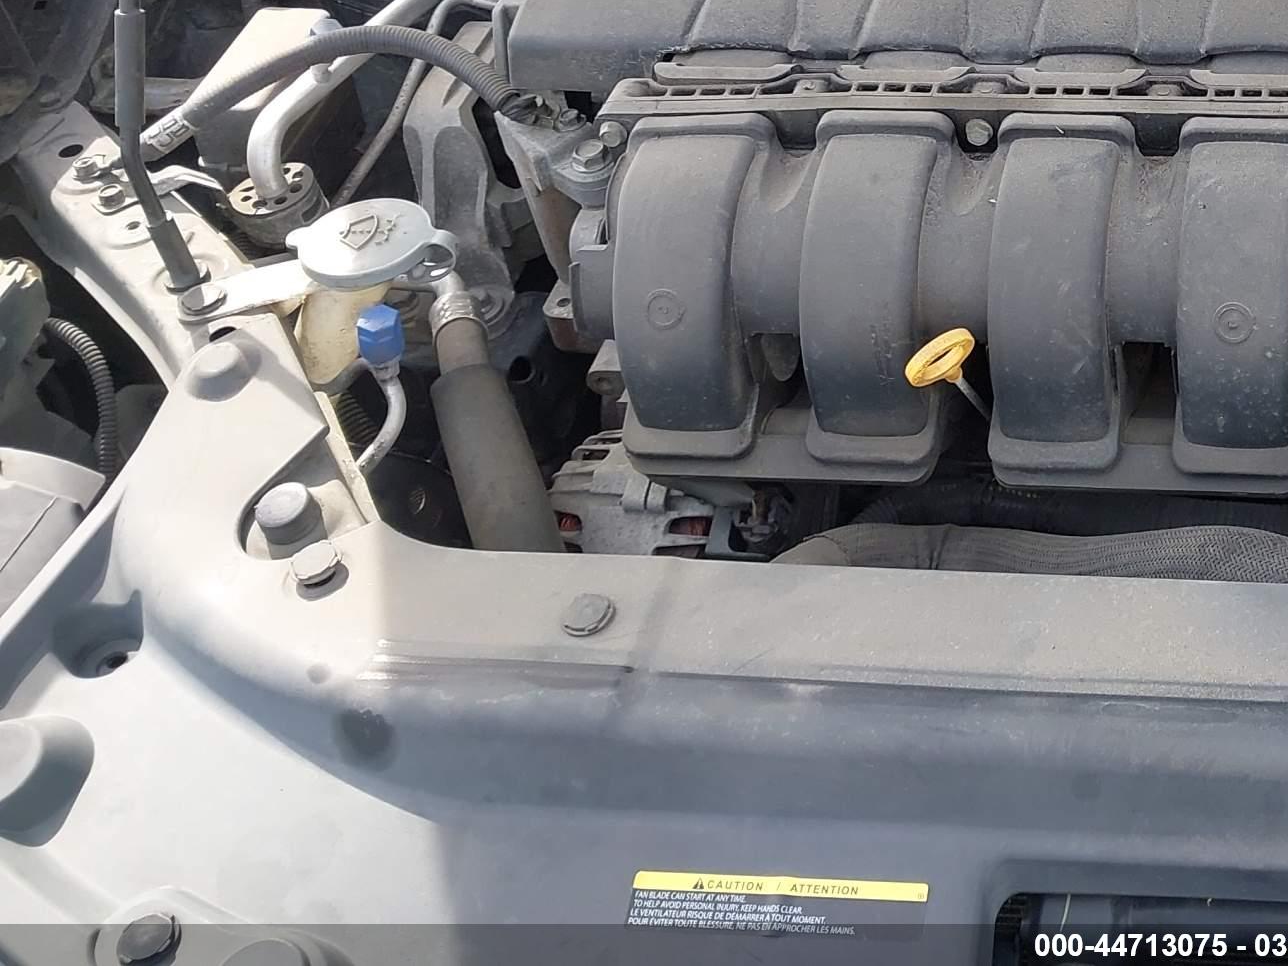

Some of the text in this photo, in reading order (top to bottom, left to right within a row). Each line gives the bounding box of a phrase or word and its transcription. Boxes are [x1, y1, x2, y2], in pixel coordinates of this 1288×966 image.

[707, 880, 764, 891] CAUTION
[790, 883, 859, 895] ATTENTION
[635, 890, 649, 899] FAN
[649, 891, 671, 900] BLADE
[671, 891, 686, 900] CAN
[686, 892, 705, 901] START
[705, 892, 715, 901] AT
[715, 893, 730, 902] ANY
[633, 899, 643, 907] TO
[643, 900, 660, 908] HELP
[660, 900, 681, 909] AVOID
[682, 901, 715, 911] PERSONAL
[740, 903, 756, 912] KEEP
[757, 904, 779, 913] HANDS
[630, 908, 638, 916] LE
[639, 908, 687, 919] VENTILATEUR
[687, 910, 713, 920] RISQUE
[713, 911, 725, 920] DE
[771, 914, 792, 923] TOUT
[628, 917, 649, 925] POUR
[674, 919, 698, 928] TOUTE
[735, 922, 746, 931] NE
[746, 922, 761, 931] PAS
[761, 923, 772, 931] EN
[771, 923, 816, 934] APPROCHER
[816, 925, 829, 934] LES
